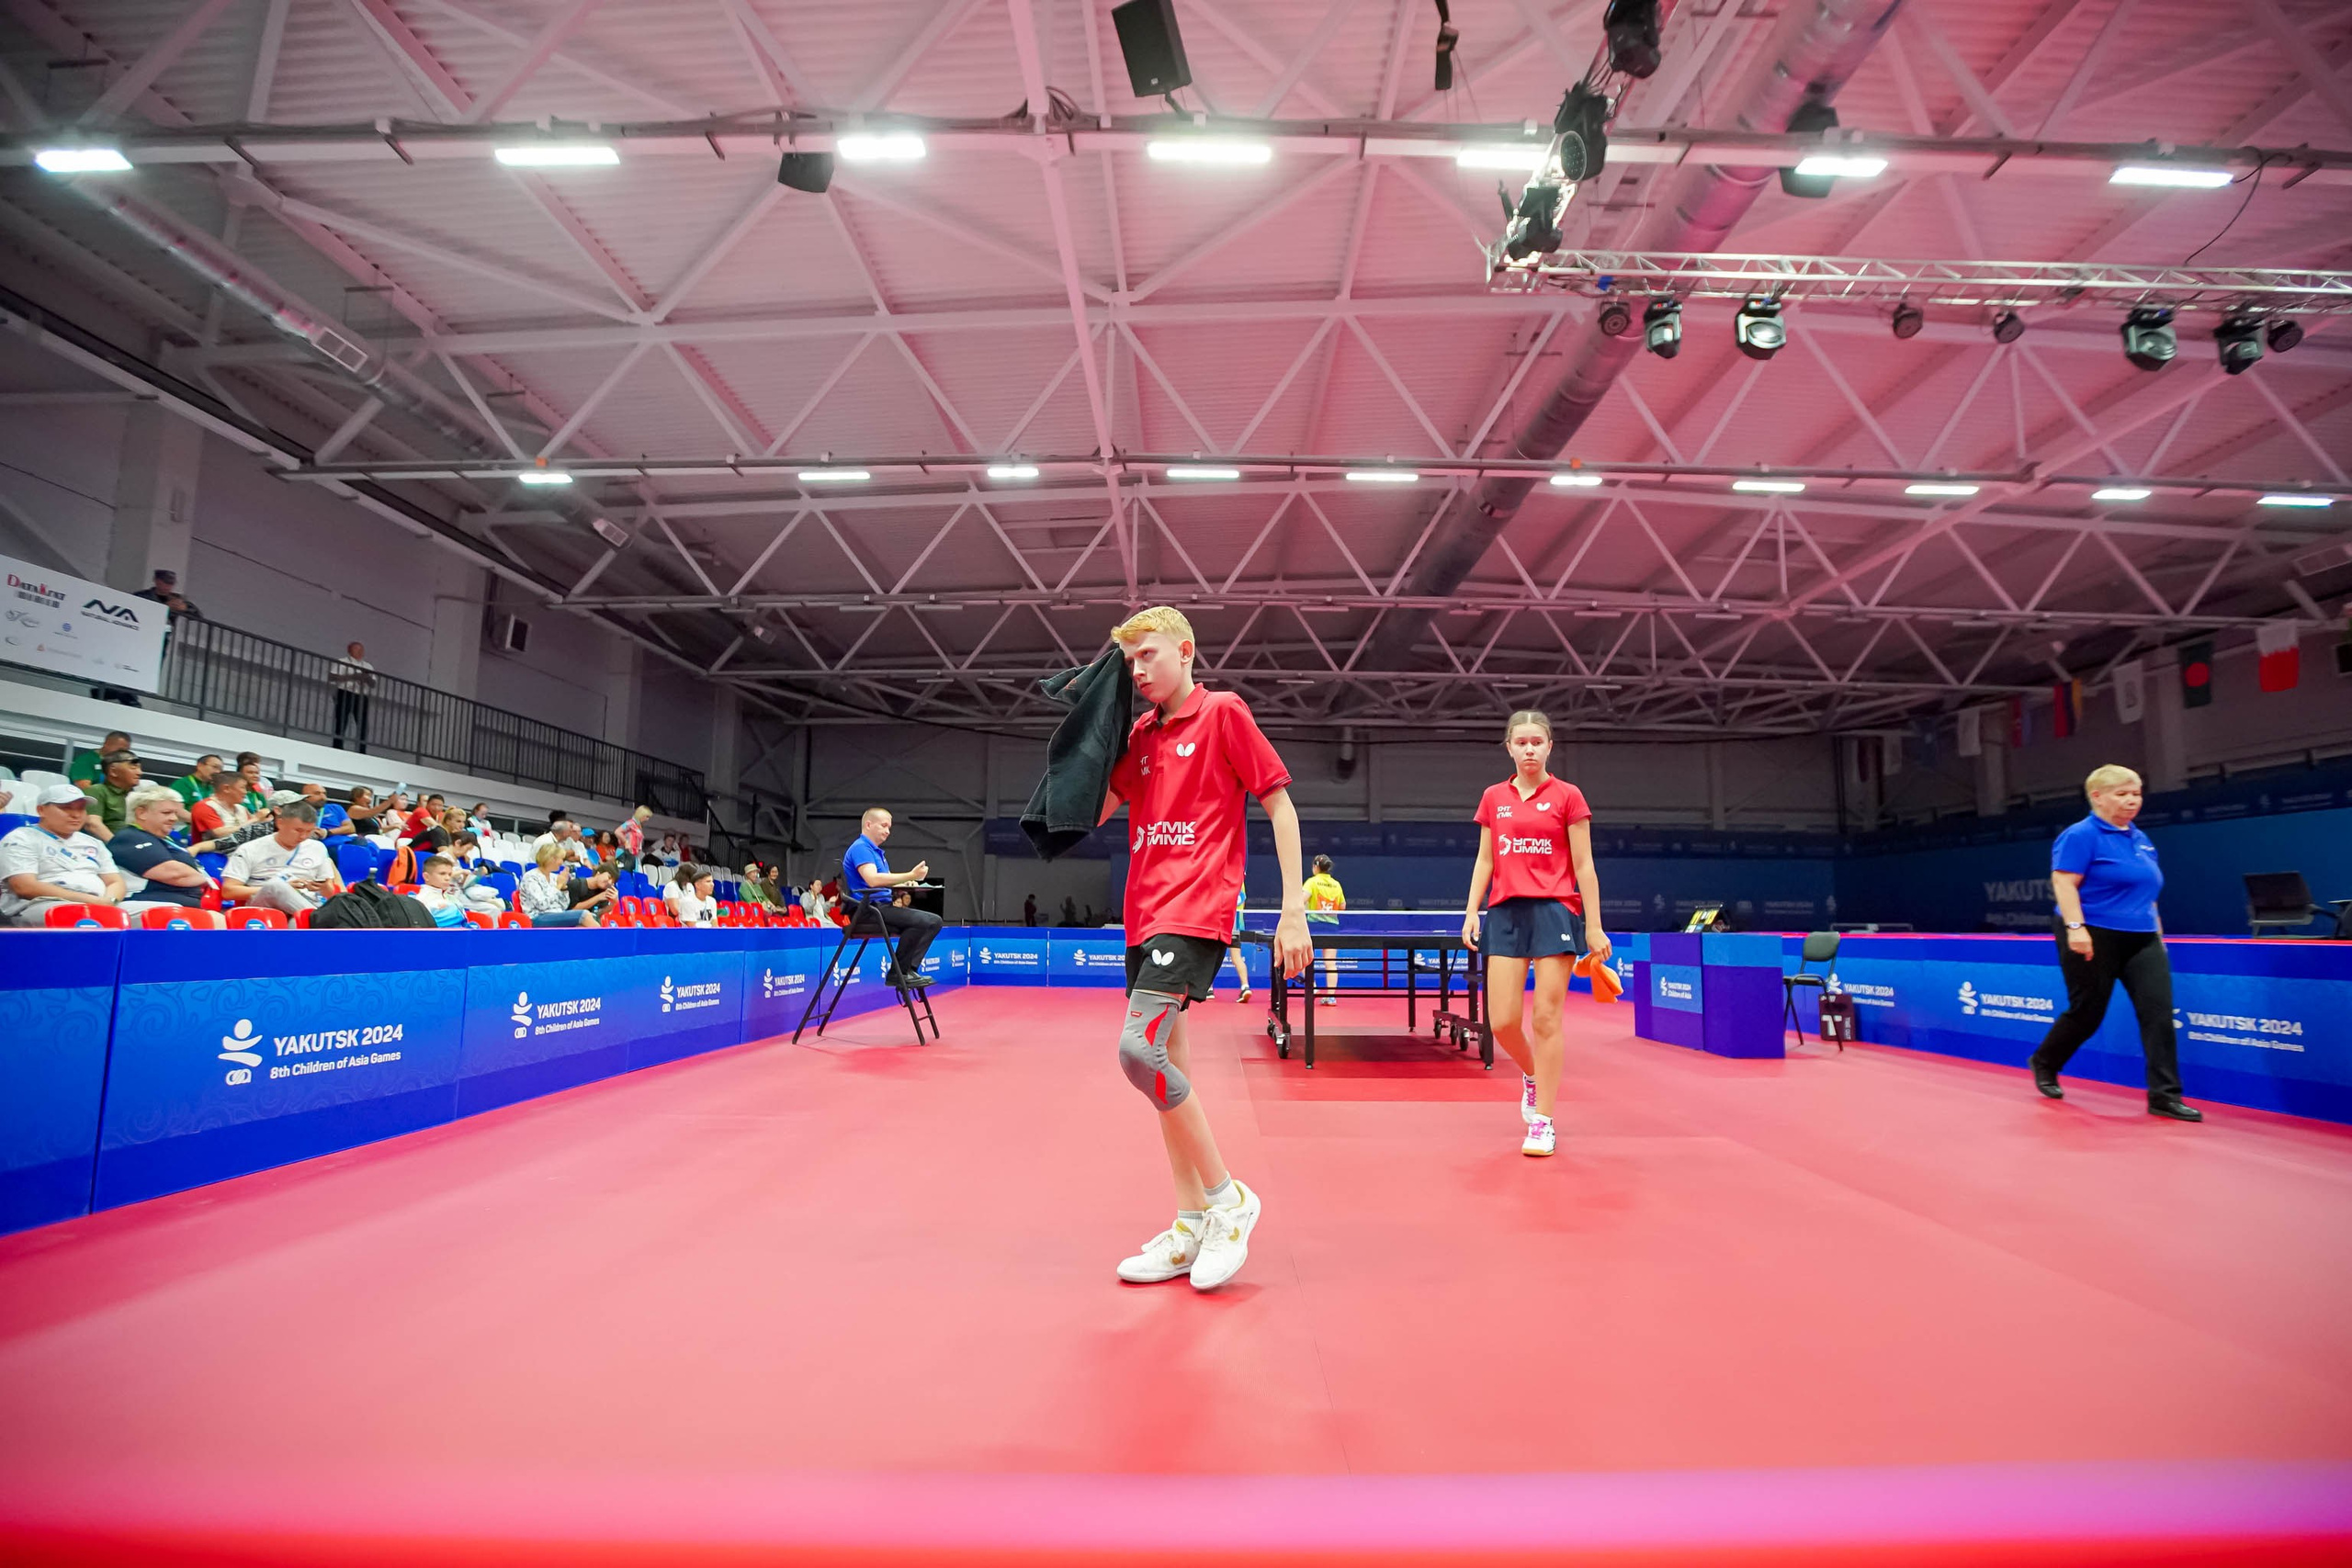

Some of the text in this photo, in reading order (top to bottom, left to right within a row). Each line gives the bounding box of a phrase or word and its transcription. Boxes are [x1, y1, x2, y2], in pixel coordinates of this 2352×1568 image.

[1512, 837, 1552, 847] УГМК
[1512, 845, 1553, 854] UMMC
[1983, 879, 2053, 902] YAKUTS
[775, 974, 805, 987] YAKUTSK 2024
[677, 983, 720, 998] YAKUTSK 2024
[1844, 984, 1894, 997] YAKUTSK 2024
[537, 998, 601, 1019] YAKUTSK 2024
[1980, 994, 2053, 1010] YAKUTSK 2024
[546, 1022, 566, 1033] Children
[2187, 1012, 2303, 1035] YAKUTSK 2024
[274, 1024, 403, 1056] YAKUTSK 2024
[270, 1052, 401, 1079] 8th Children of Asia Games
